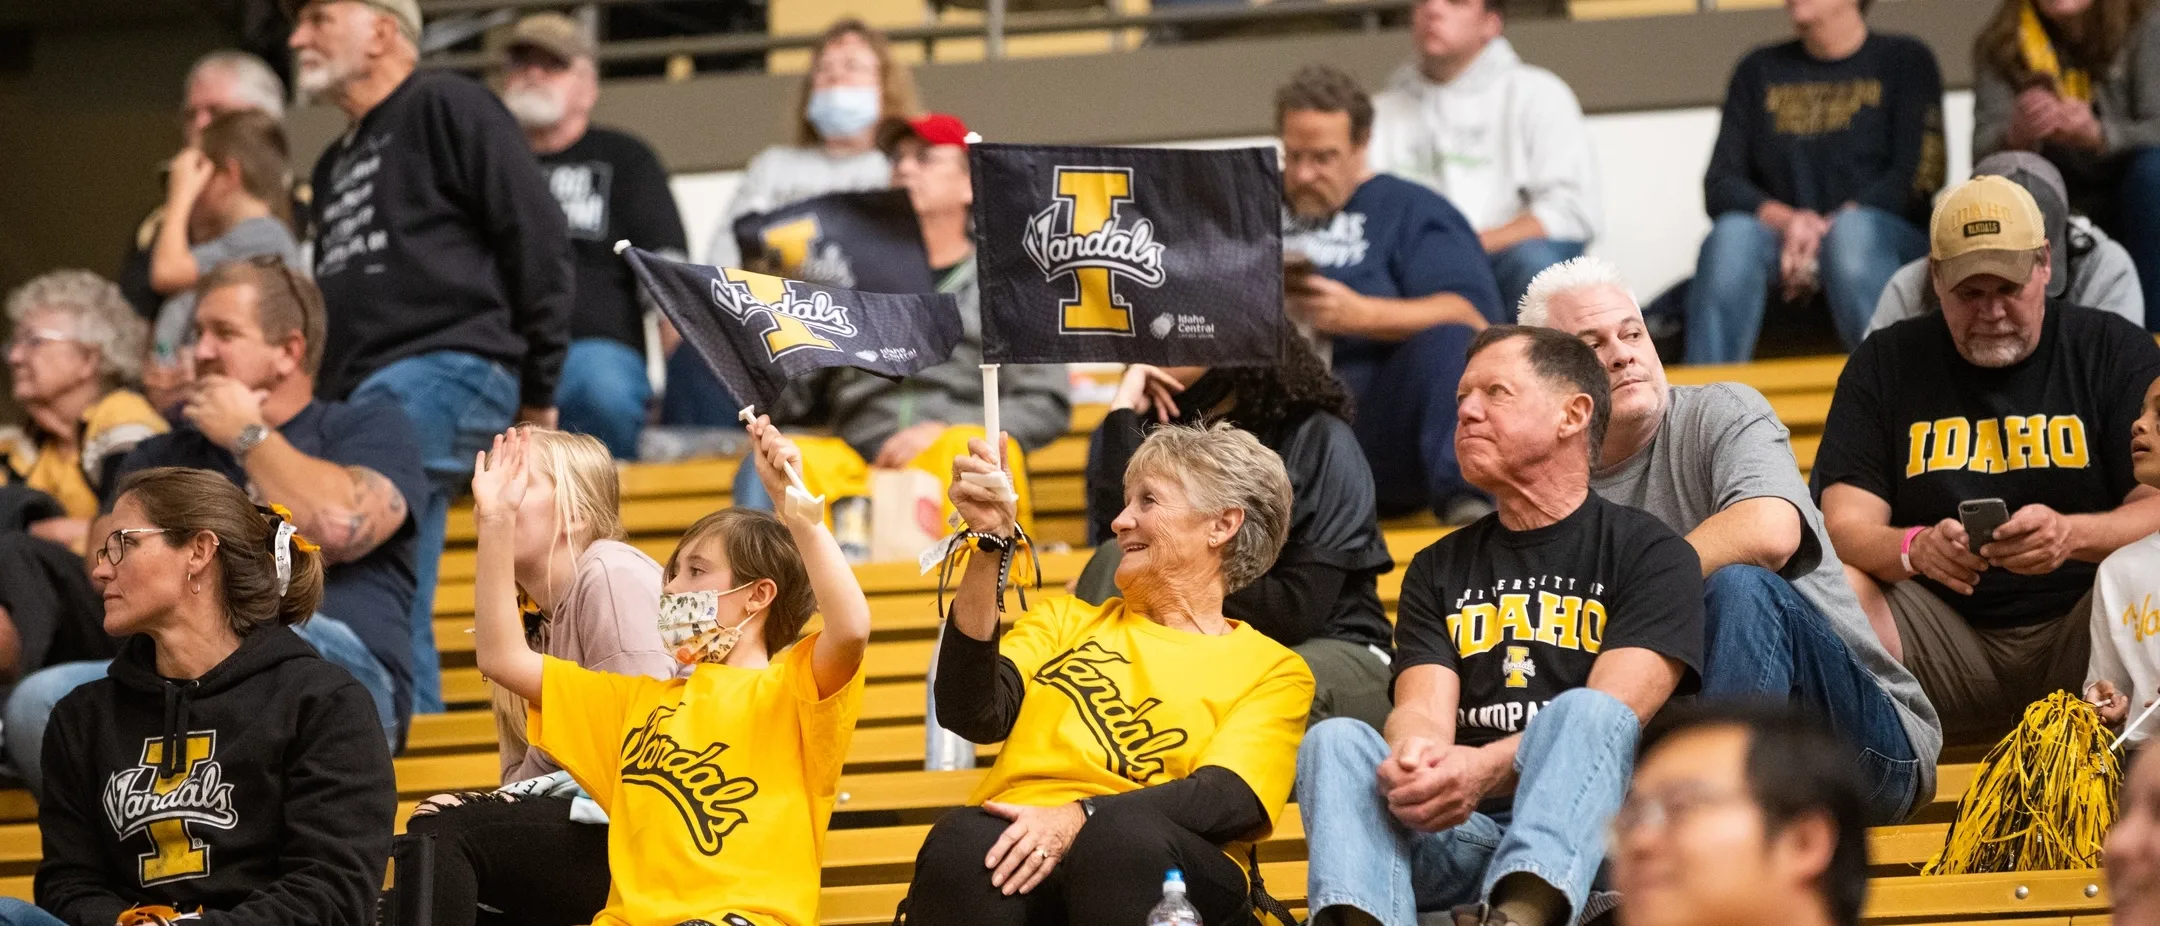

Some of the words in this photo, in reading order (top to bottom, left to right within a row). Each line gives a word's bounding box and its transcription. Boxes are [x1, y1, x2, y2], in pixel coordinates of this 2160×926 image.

[1022, 201, 1167, 288] Vandals
[1950, 201, 2013, 232] IDAHO
[710, 278, 858, 339] Vadals
[1178, 314, 1205, 324] Idaho
[1178, 324, 1215, 333] Central
[1906, 413, 2089, 479] IDAHO
[1446, 590, 1608, 660] IDAHO
[1033, 640, 1189, 783] Vandals
[102, 761, 239, 842] Vandals
[621, 702, 759, 857] Vandals
